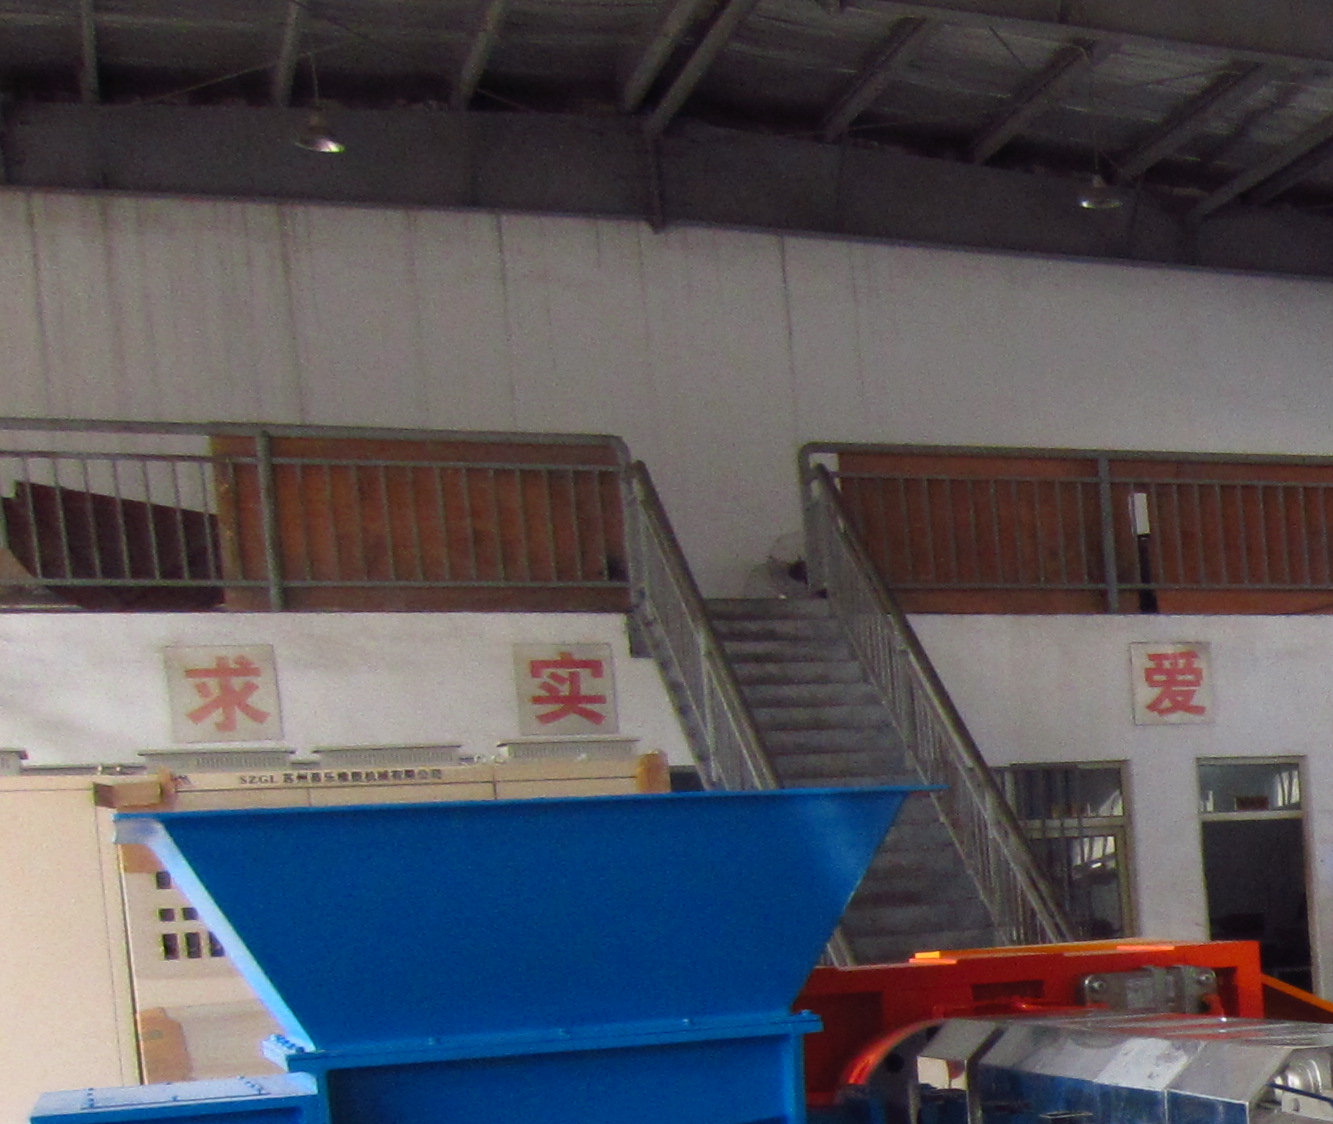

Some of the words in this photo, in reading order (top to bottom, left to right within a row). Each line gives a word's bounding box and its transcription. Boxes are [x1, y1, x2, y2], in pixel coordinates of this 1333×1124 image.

[184, 654, 271, 732] 求
[529, 651, 607, 725] 实
[1144, 650, 1206, 717] 爱
